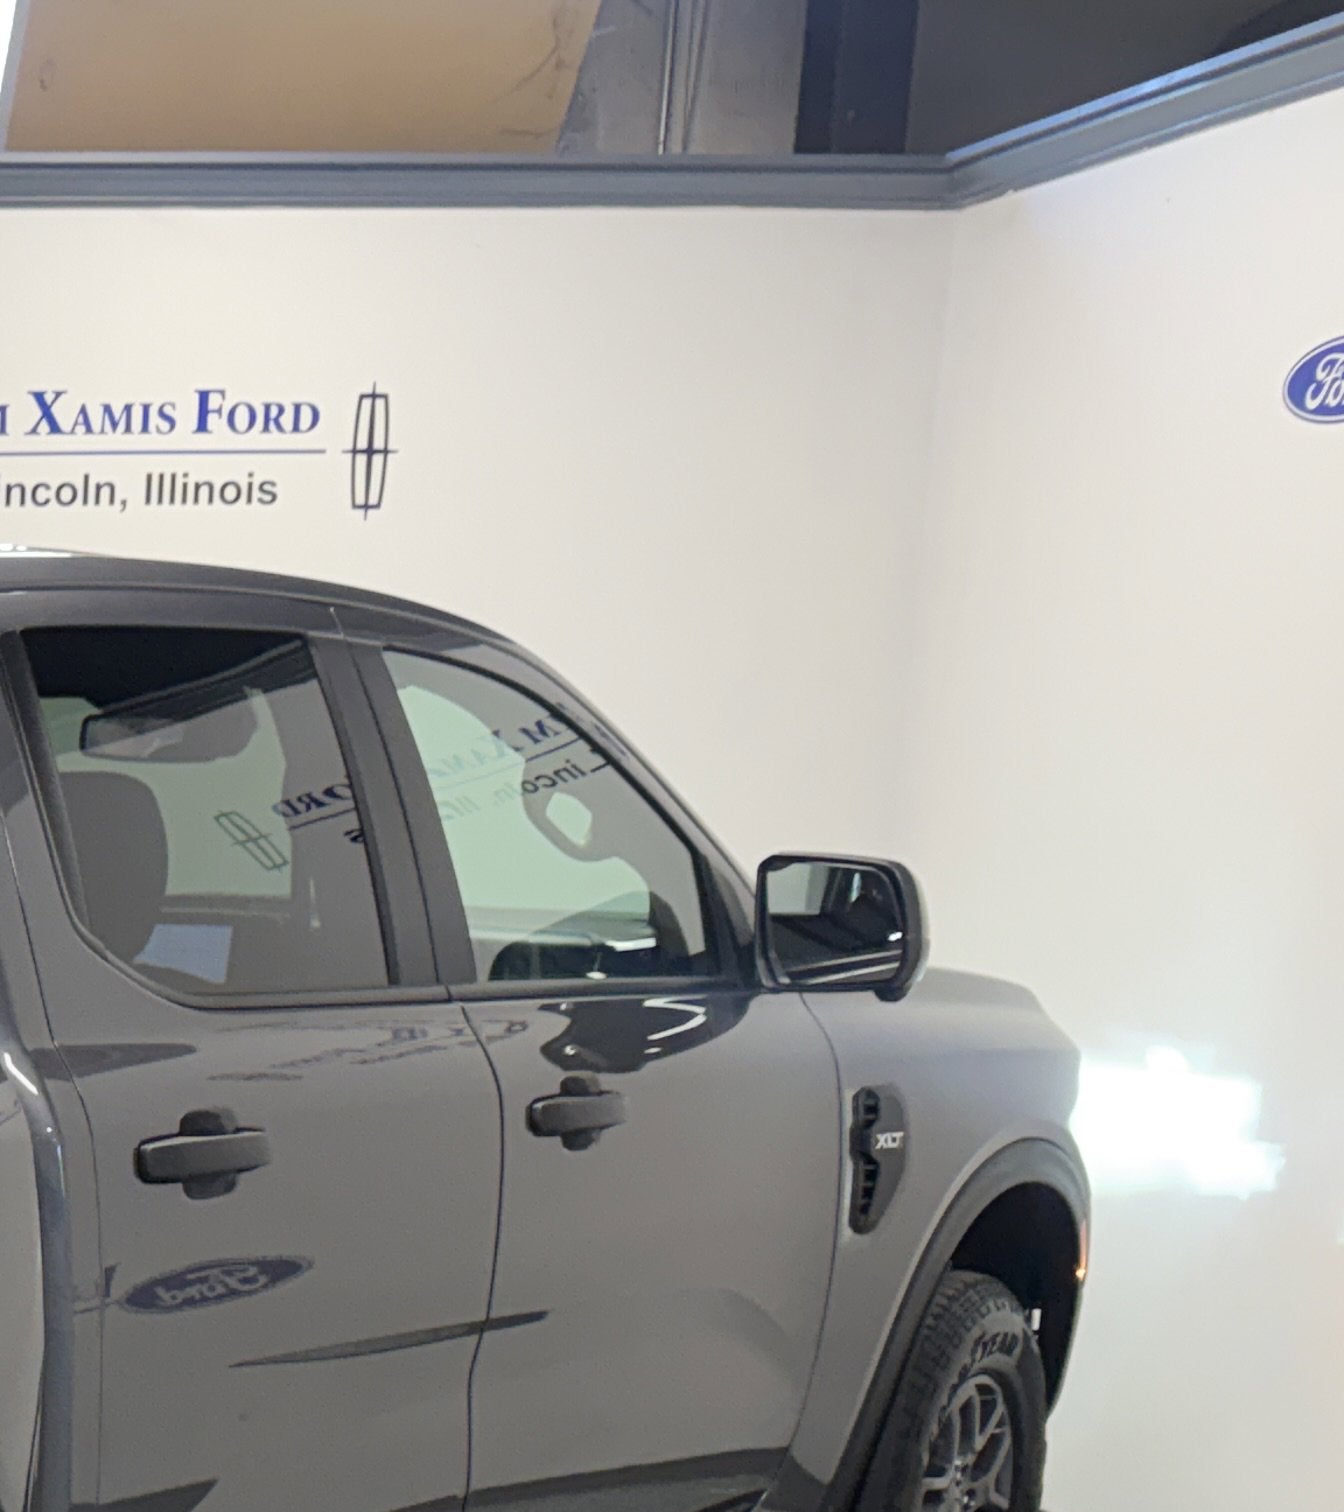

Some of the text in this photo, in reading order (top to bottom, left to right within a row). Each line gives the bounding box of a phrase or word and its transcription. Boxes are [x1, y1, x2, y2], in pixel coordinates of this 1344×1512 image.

[24, 390, 178, 436] XAMIS
[193, 389, 321, 436] FORD
[144, 472, 279, 507] Illinois
[875, 1131, 904, 1150] XLT
